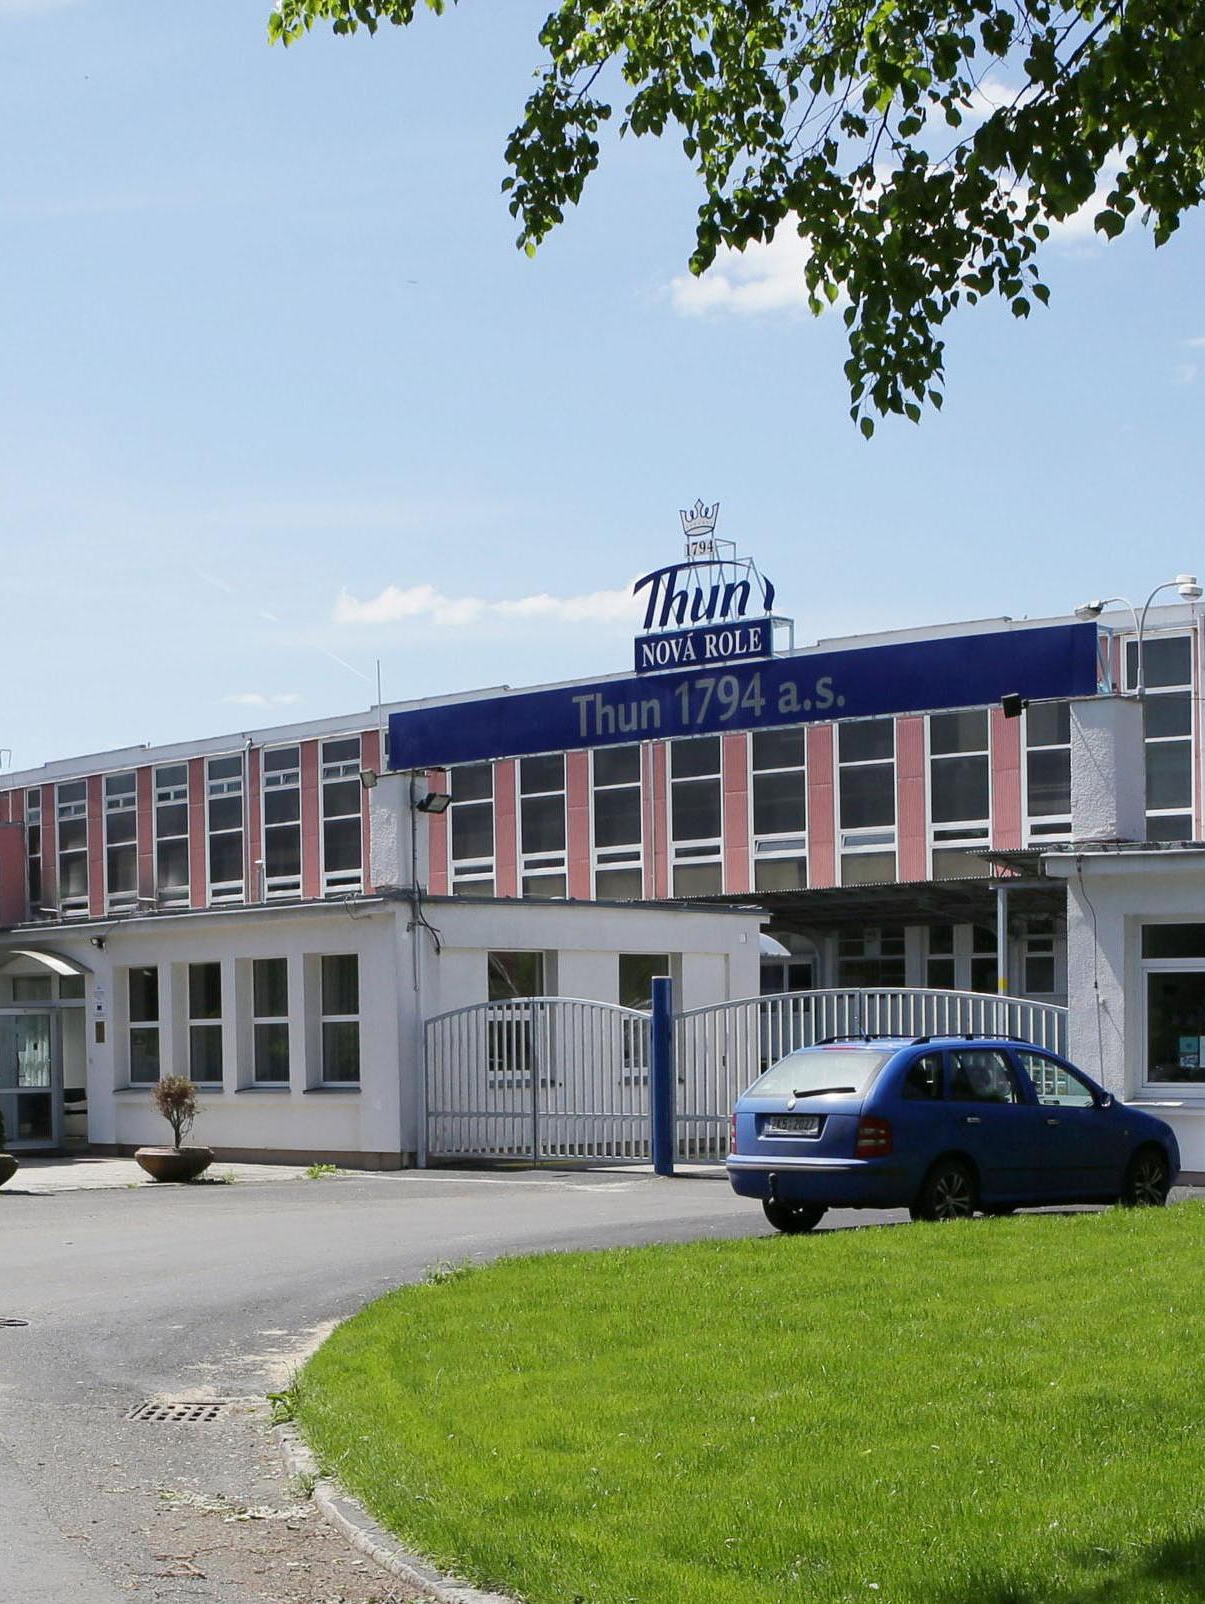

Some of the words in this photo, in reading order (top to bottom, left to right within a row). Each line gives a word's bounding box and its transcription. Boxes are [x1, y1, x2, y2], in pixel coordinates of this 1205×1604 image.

[685, 540, 714, 557] 1794
[633, 560, 775, 629] Thun
[642, 633, 697, 667] NOVÁ
[704, 627, 762, 658] ROLE
[572, 693, 661, 737] Thun
[675, 672, 765, 725] 1794
[778, 676, 845, 714] a.s.
